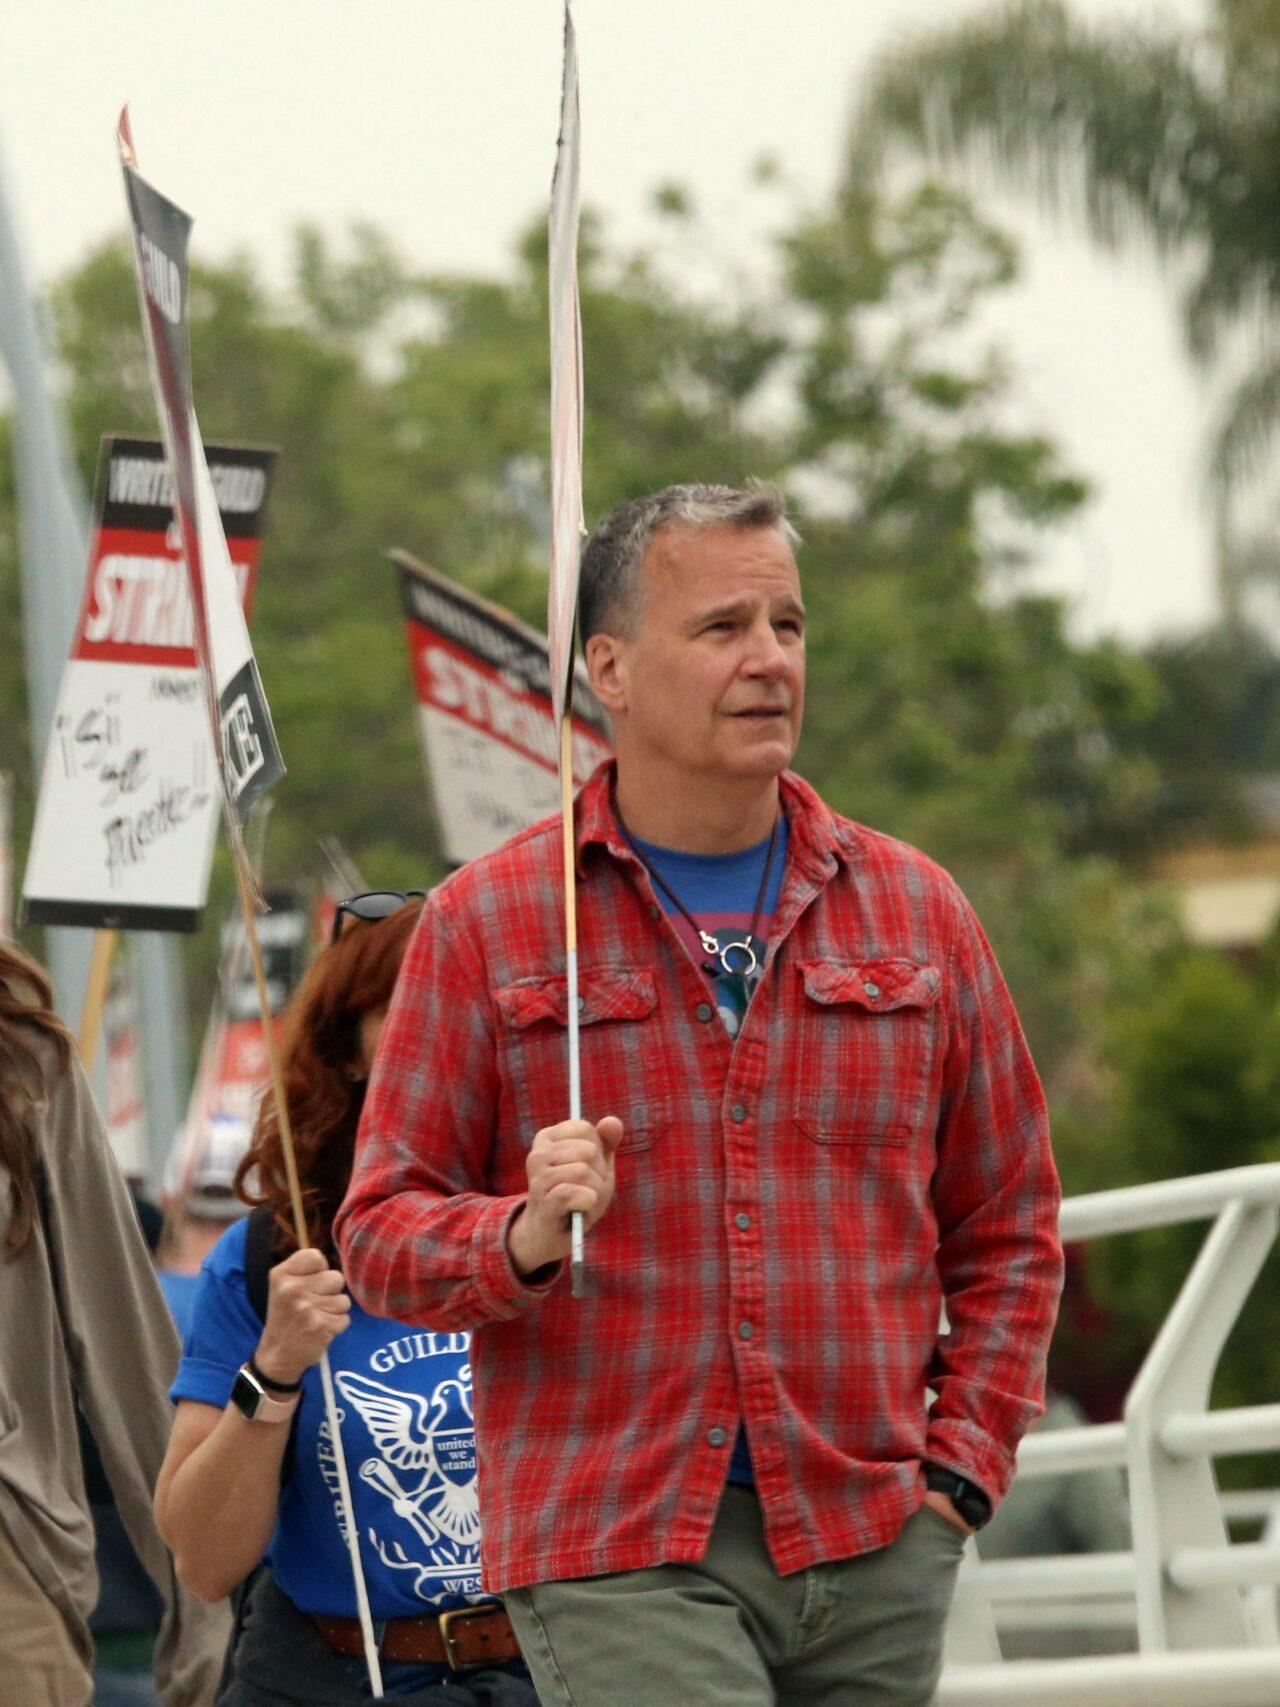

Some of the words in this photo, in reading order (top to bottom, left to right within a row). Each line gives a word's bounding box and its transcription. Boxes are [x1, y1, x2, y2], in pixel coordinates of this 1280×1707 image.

[369, 1331, 472, 1373] GUILD
[437, 1435, 476, 1451] united
[449, 1450, 468, 1460] we
[442, 1456, 476, 1471] stand
[442, 1576, 482, 1594] WES
